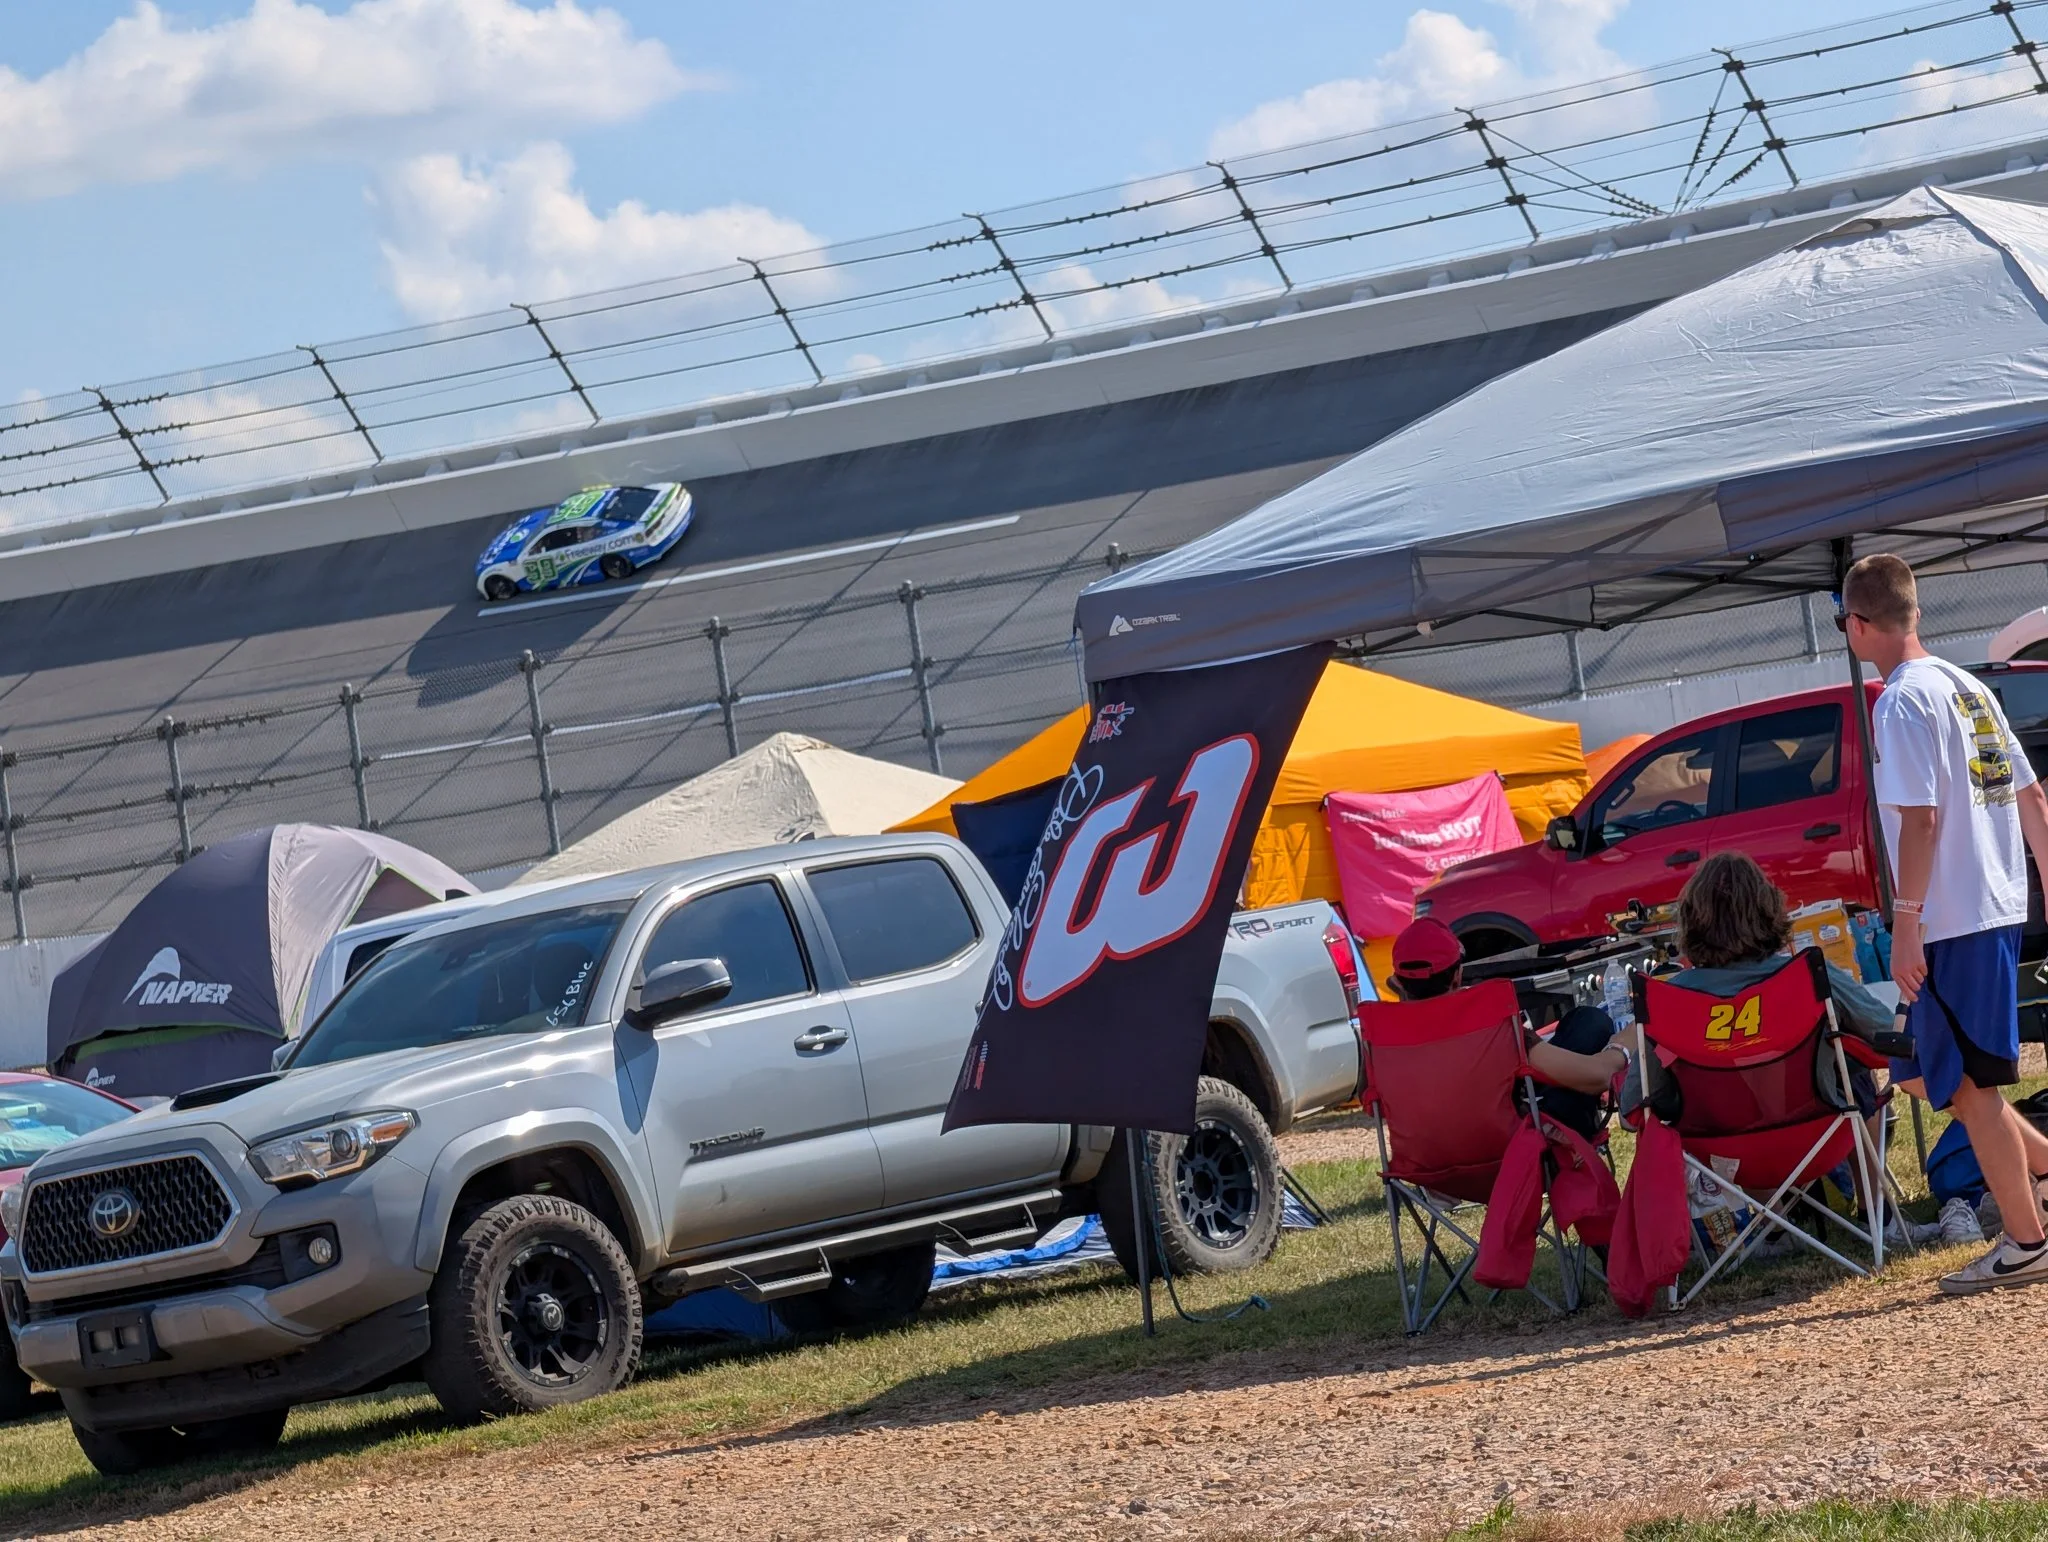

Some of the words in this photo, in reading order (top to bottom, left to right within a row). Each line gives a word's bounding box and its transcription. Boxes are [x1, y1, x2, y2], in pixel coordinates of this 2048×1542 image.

[1018, 733, 1261, 1008] 3
[1272, 916, 1315, 930] SPORT
[139, 981, 233, 1006] NAPIER
[566, 961, 594, 995] Blue
[1705, 993, 1762, 1041] 24
